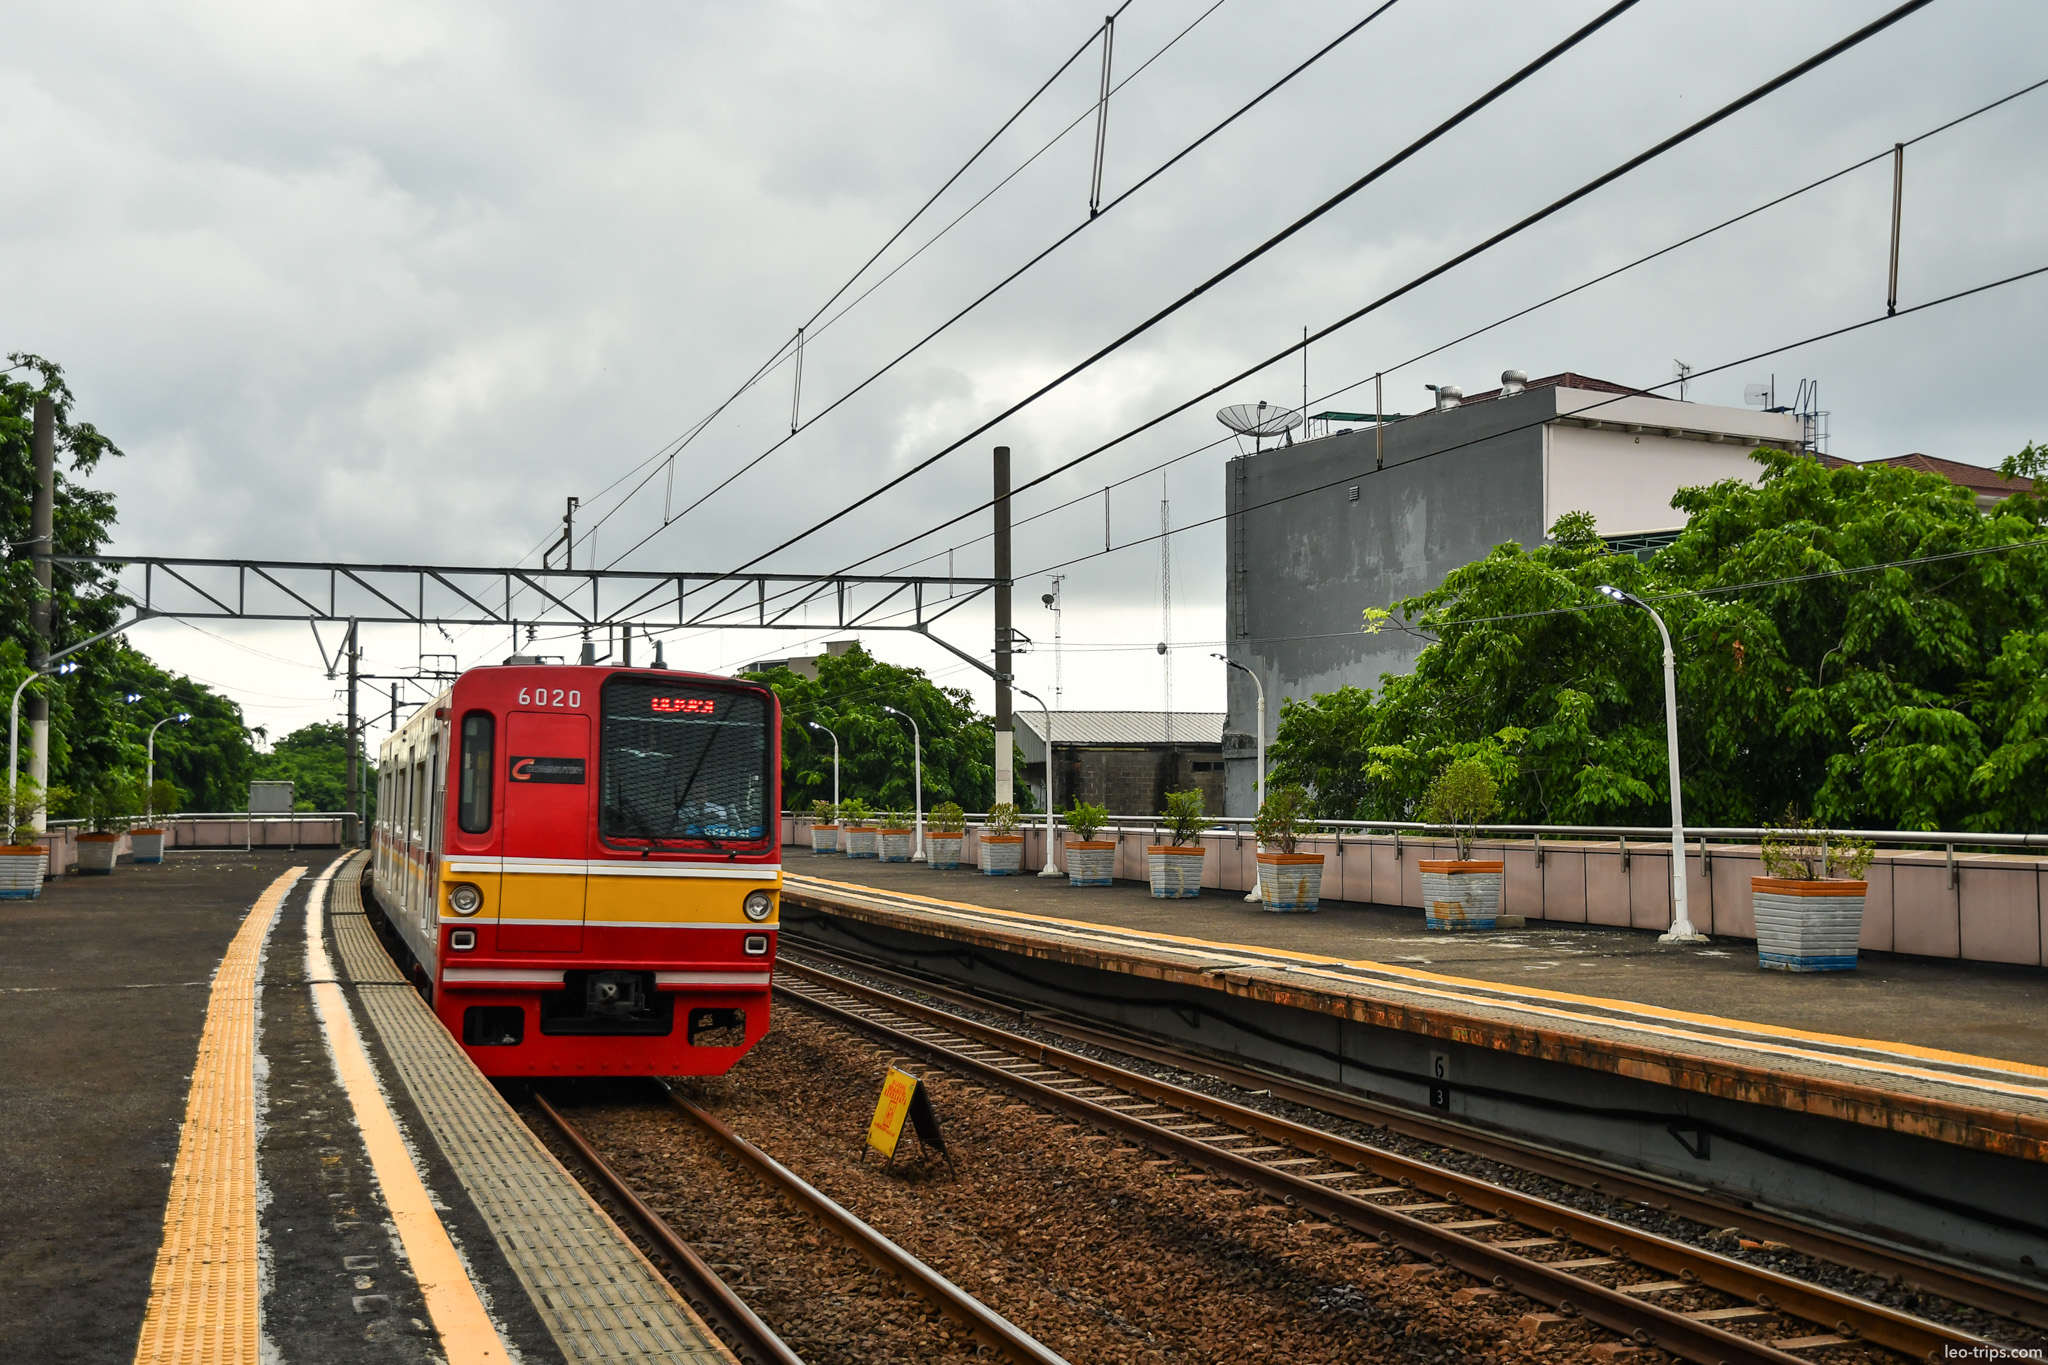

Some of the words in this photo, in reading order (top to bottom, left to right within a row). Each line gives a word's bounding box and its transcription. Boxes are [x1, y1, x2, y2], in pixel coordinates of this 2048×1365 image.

[518, 687, 581, 708] 6020
[1435, 1056, 1444, 1079] 6
[1437, 1089, 1444, 1105] 3
